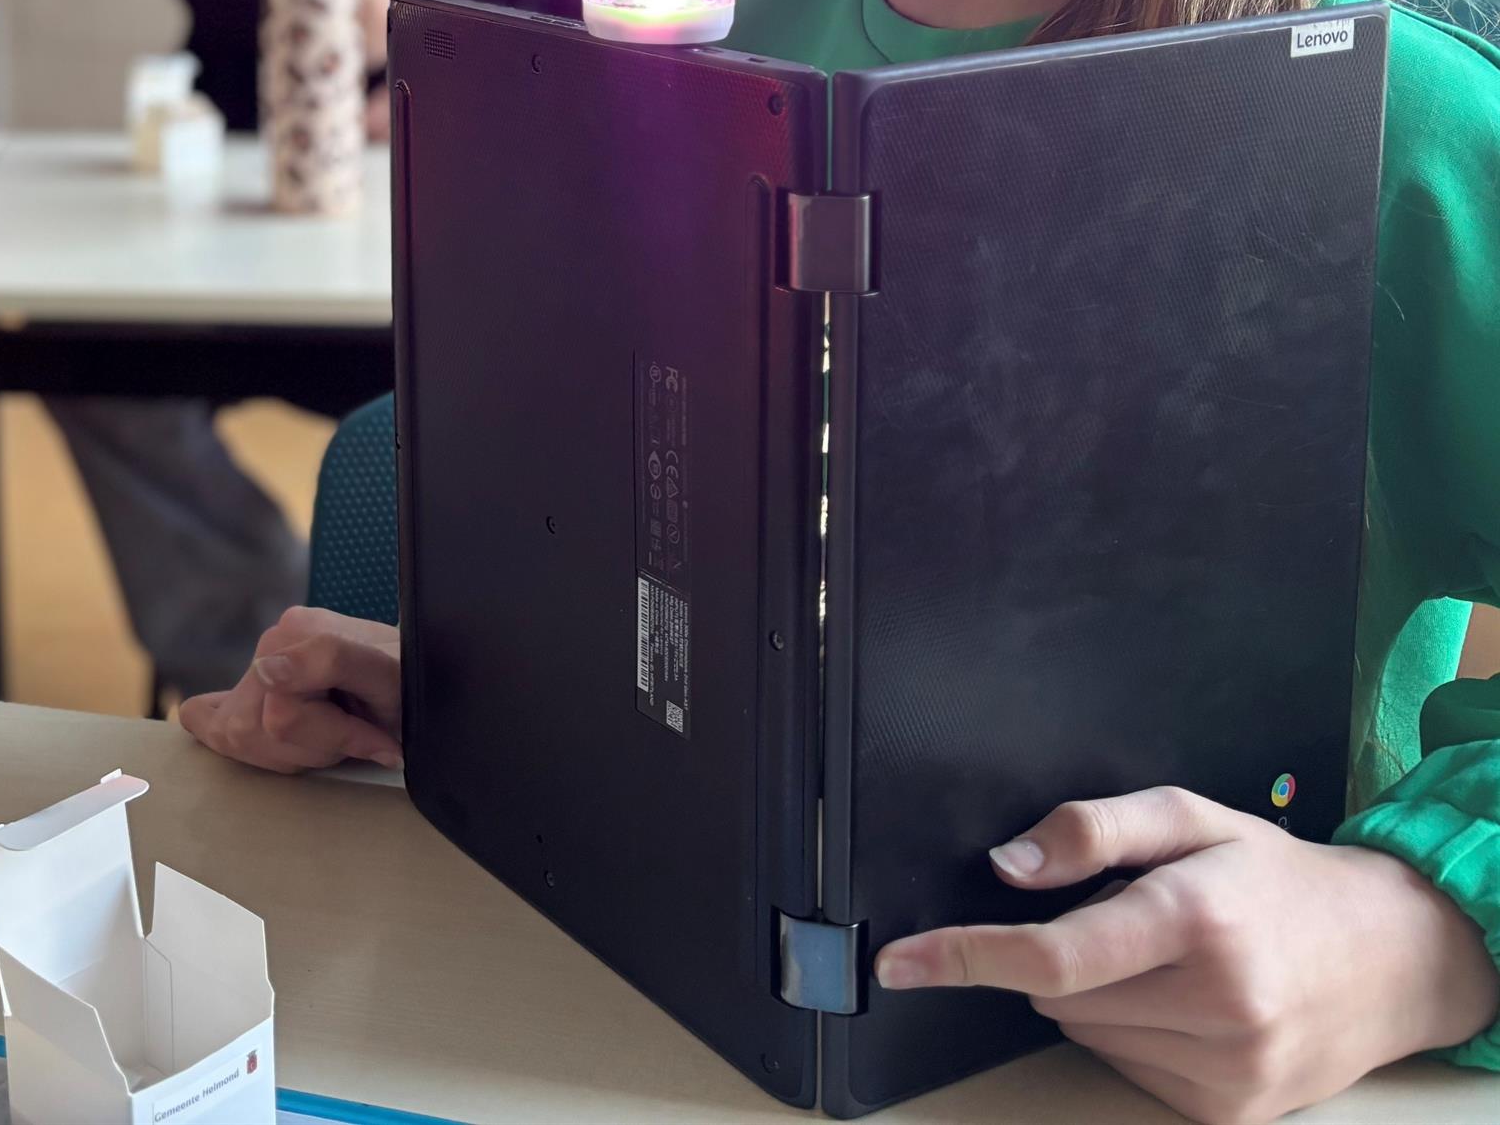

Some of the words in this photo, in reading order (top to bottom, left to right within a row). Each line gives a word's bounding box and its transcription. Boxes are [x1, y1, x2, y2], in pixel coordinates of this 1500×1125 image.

[1296, 30, 1349, 49] Lenovo
[154, 1094, 200, 1123] Gemeente
[202, 1067, 240, 1098] Helmond
